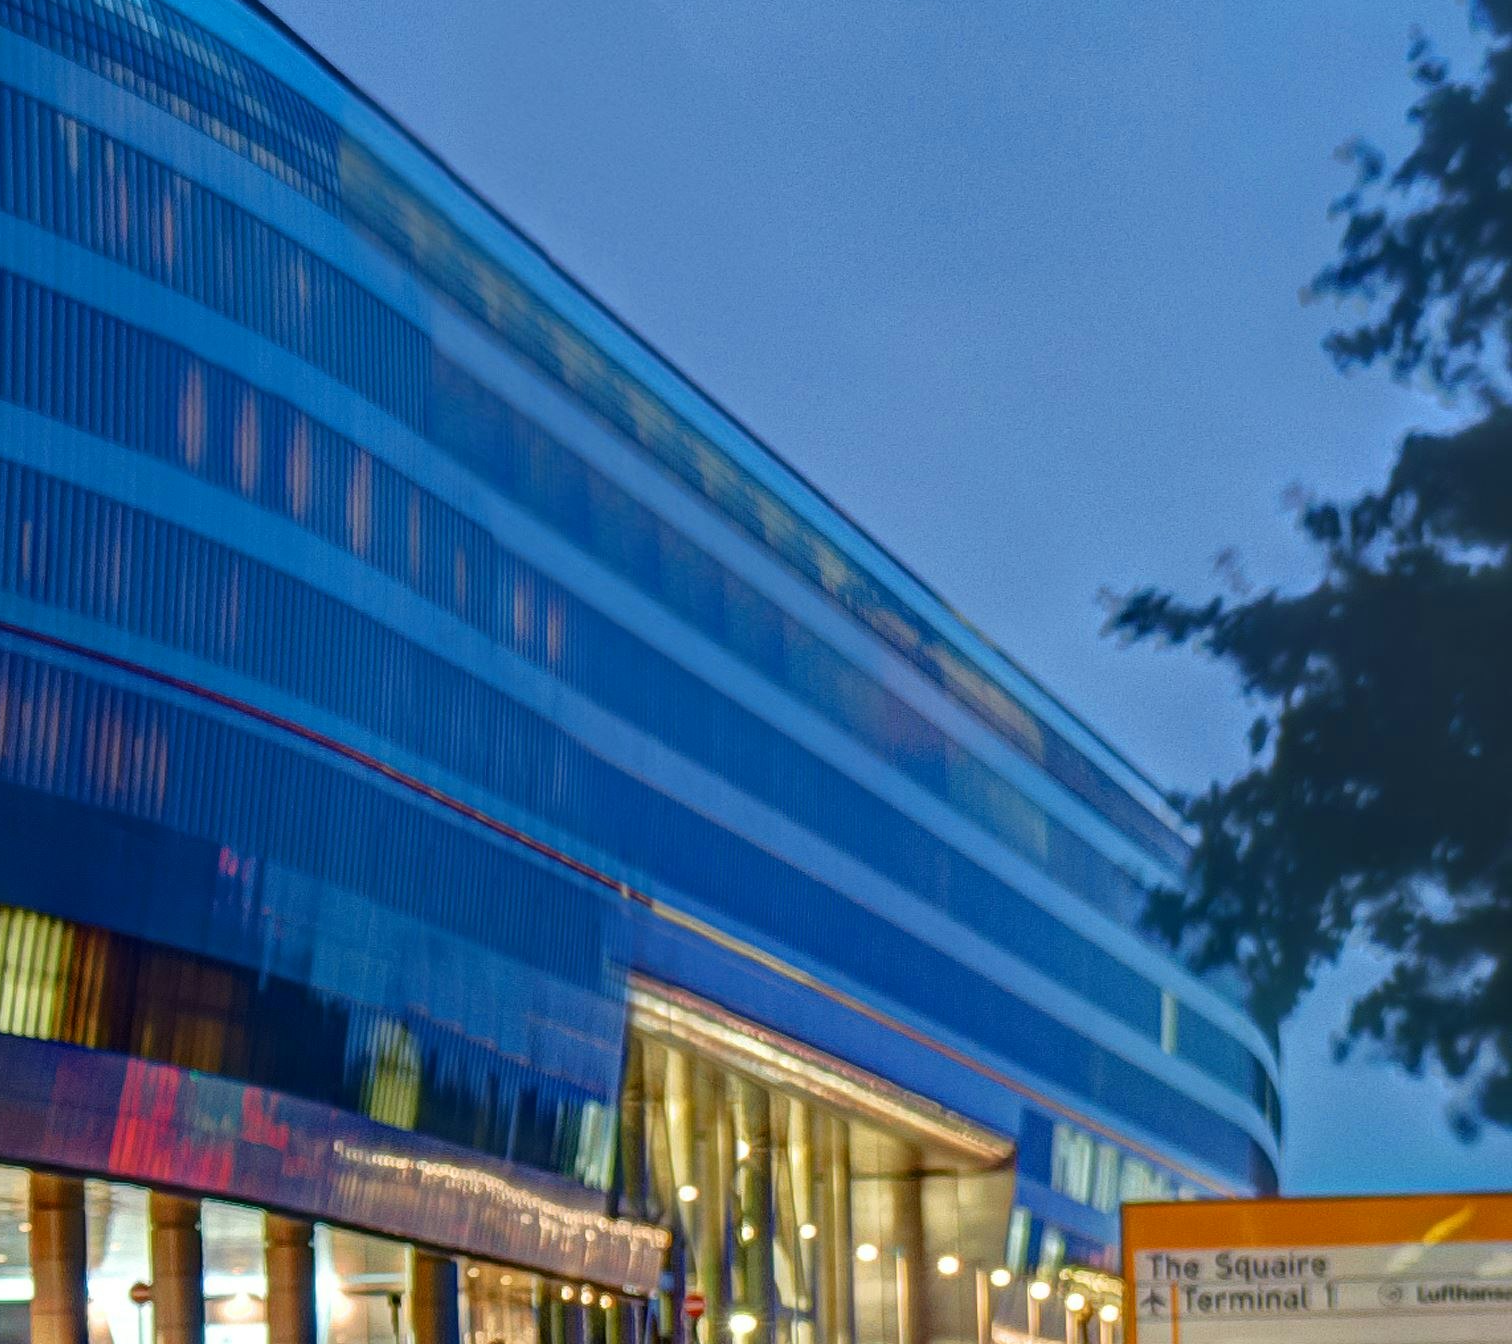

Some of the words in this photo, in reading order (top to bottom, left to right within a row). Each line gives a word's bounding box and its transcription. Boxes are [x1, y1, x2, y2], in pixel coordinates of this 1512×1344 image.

[1146, 1253, 1200, 1279] The
[1214, 1251, 1327, 1282] Squaire
[1183, 1280, 1310, 1312] Terminal
[1324, 1279, 1334, 1308] 1
